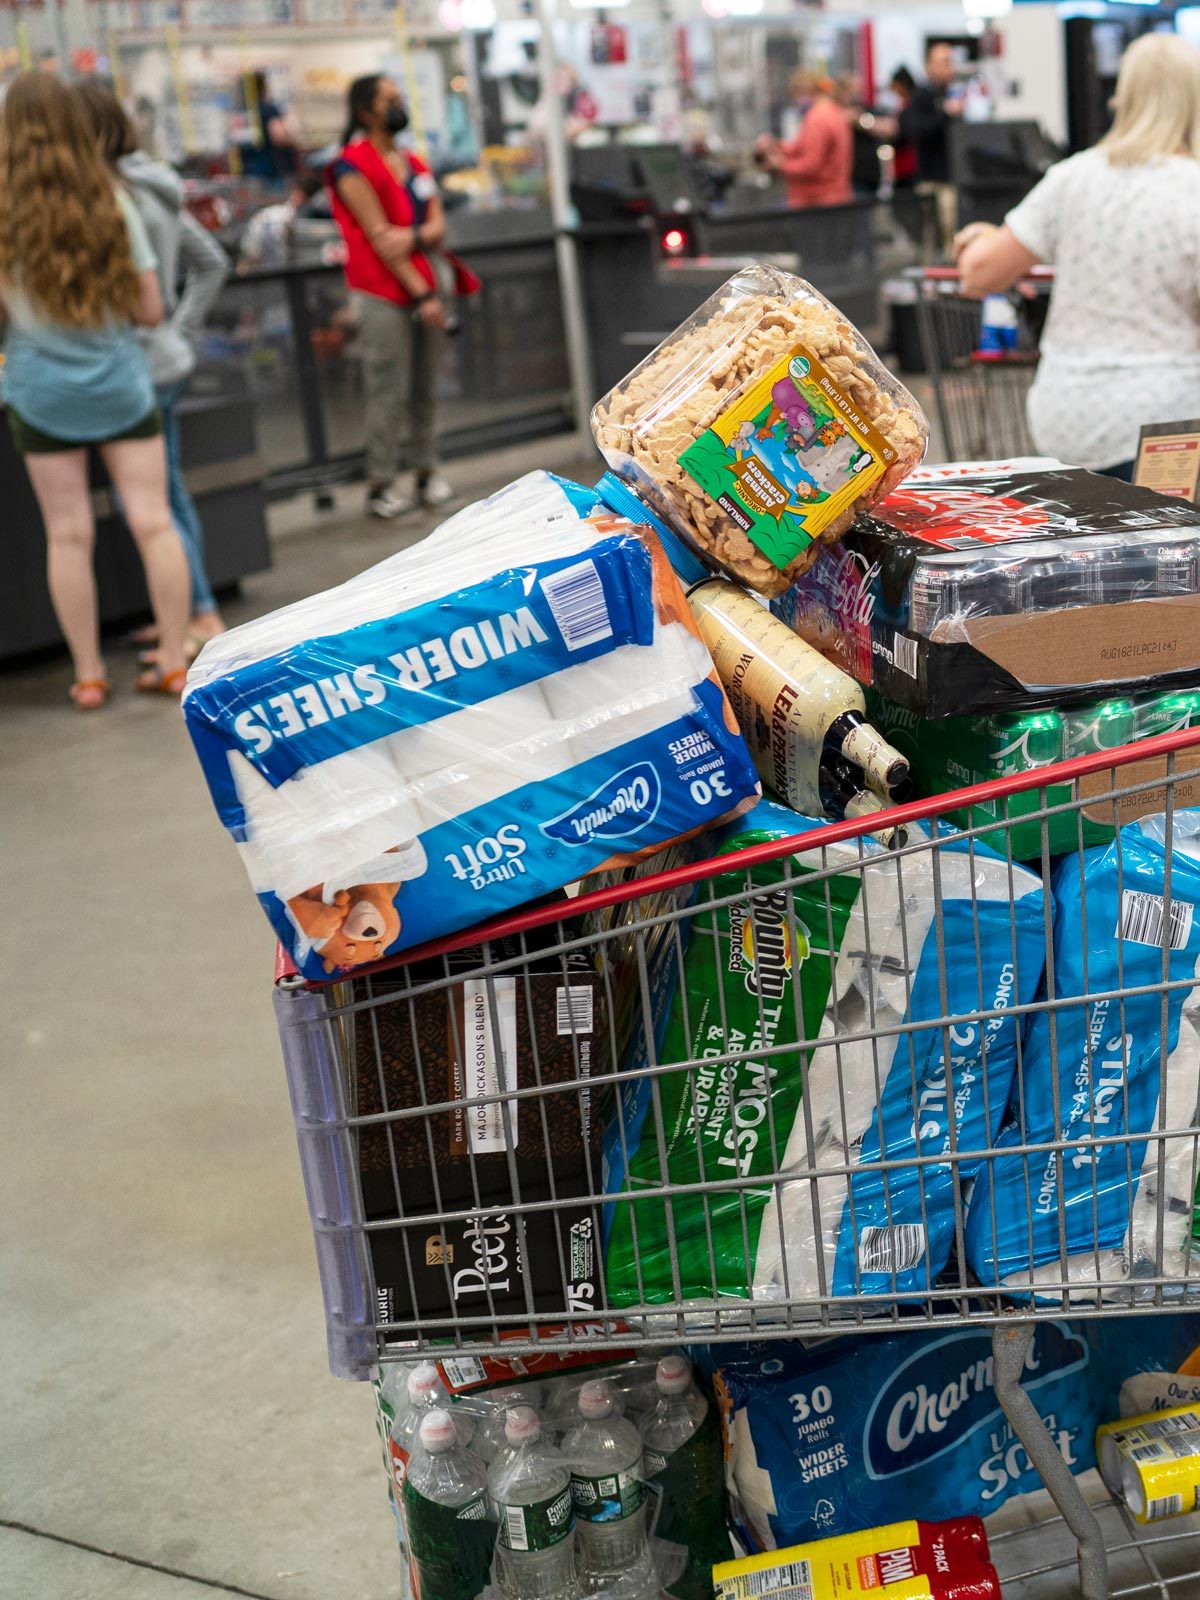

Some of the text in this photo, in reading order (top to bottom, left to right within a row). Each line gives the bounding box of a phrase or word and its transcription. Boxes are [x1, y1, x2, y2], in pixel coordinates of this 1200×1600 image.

[838, 399, 849, 410] LB
[849, 411, 861, 424] WT
[856, 421, 870, 435] NET
[743, 471, 775, 508] Animal
[746, 460, 785, 505] Crackers
[719, 496, 751, 531] KIRKLAND
[388, 606, 550, 691] WIDER
[668, 729, 711, 755] SHEETS
[673, 738, 716, 765] WIDER
[696, 756, 726, 776] JUMBO
[690, 770, 733, 806] 30
[571, 776, 651, 838] Charmin
[444, 824, 527, 881] Soft
[471, 857, 527, 891] Ultra
[744, 883, 793, 999] Bounty
[707, 1025, 724, 1041] &
[474, 995, 488, 1141] MAJOR DICKASON'S BLEND
[718, 1005, 782, 1177] THE MOST
[454, 1094, 463, 1119] ROST
[455, 1121, 463, 1142] DARK
[377, 1288, 389, 1332] EURIG
[568, 1283, 595, 1312] 75
[788, 1384, 833, 1423] 30
[886, 1335, 1042, 1452] Charm
[1167, 1382, 1188, 1400] Our
[797, 1415, 835, 1440] JUMBO
[807, 1429, 830, 1444] Rolls
[991, 1414, 1057, 1452] Ula
[799, 1442, 845, 1471] WIDER
[802, 1457, 849, 1484] SHEETS
[979, 1429, 1078, 1500] Sot
[816, 1517, 836, 1529] FSC
[864, 1557, 876, 1587] ORIGINAL
[878, 1547, 915, 1585] PAM
[934, 1550, 950, 1572] PACK
